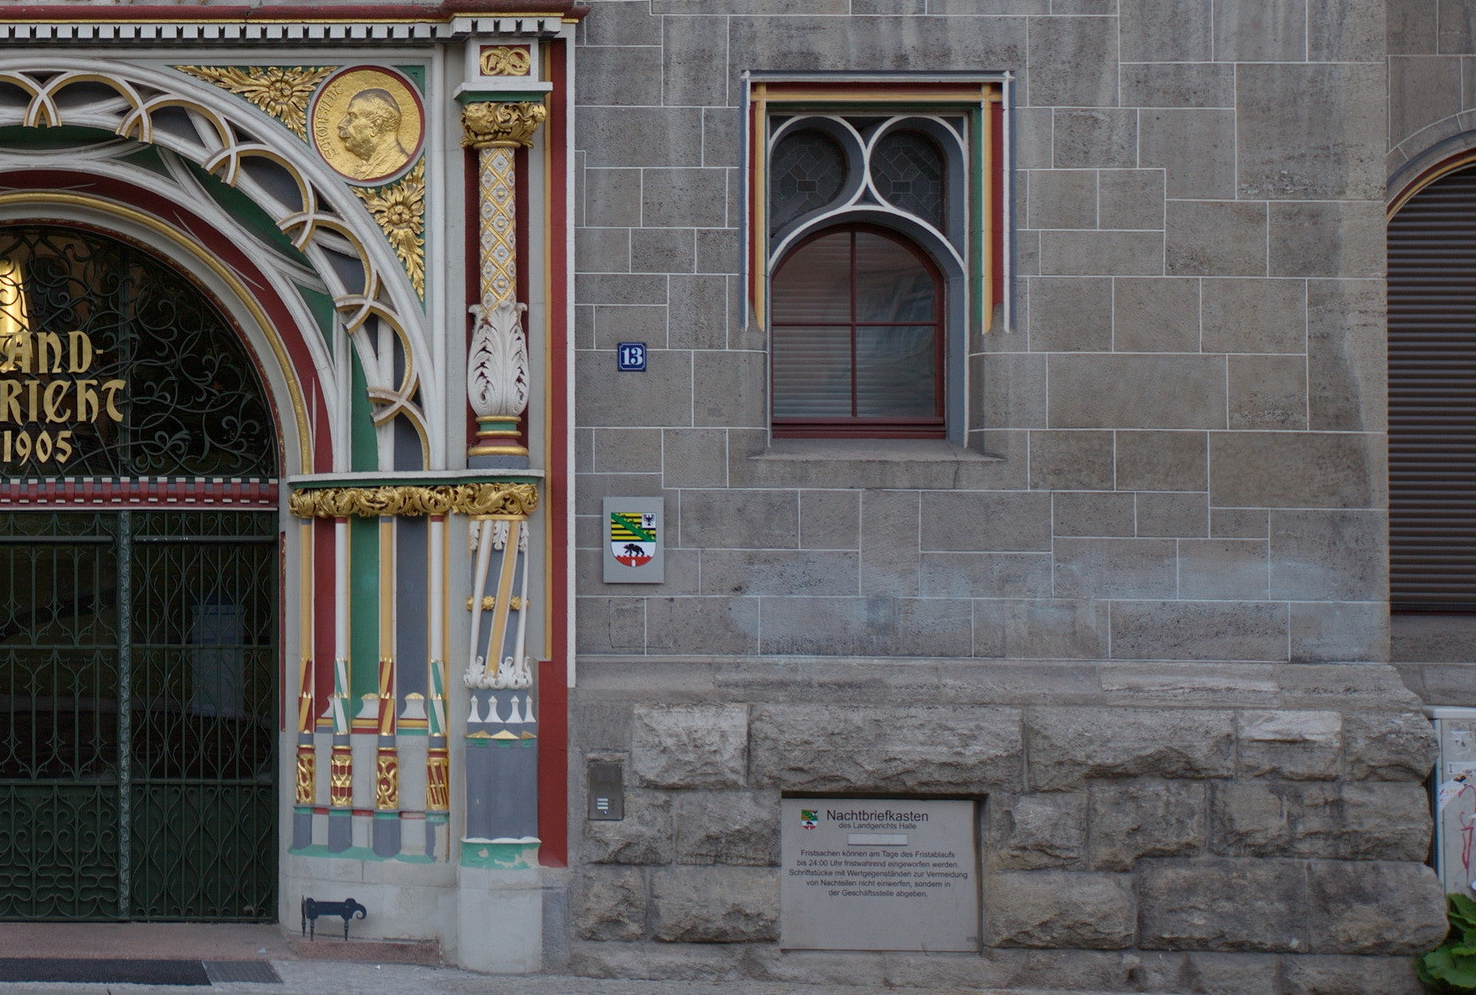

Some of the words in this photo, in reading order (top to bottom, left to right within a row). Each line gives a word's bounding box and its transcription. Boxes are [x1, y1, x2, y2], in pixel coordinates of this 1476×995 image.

[622, 347, 643, 365] 13
[3, 431, 72, 466] 1905
[827, 810, 929, 822] Nachtbriefkasten
[883, 851, 899, 859] Tage
[888, 861, 930, 869] eingeworfen
[847, 870, 911, 878] Wertgegenständen
[926, 871, 968, 879] Vermeidung
[896, 890, 928, 898] abgeben.
